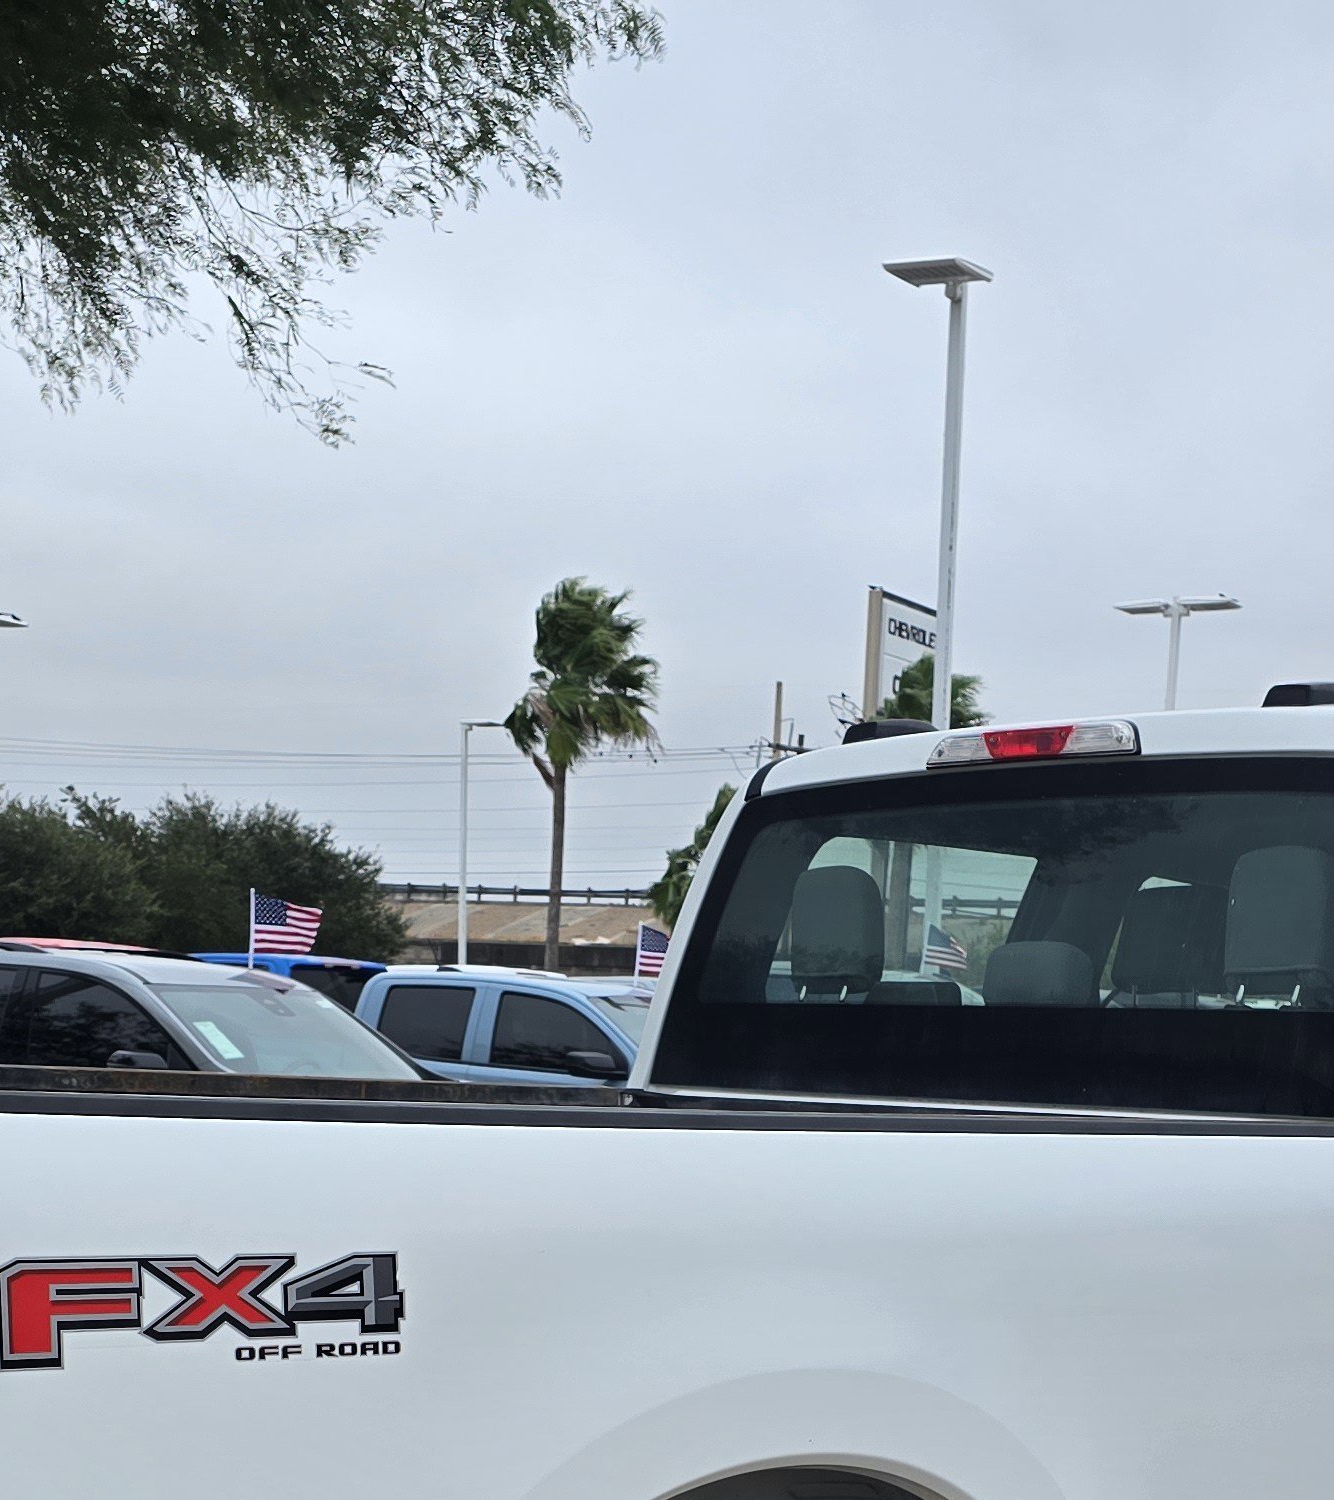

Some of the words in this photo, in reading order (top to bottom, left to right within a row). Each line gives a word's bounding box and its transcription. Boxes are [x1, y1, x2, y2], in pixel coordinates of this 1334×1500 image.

[888, 617, 937, 649] CHEVROLE
[234, 1345, 302, 1362] OFF
[316, 1340, 402, 1359] ROAD
